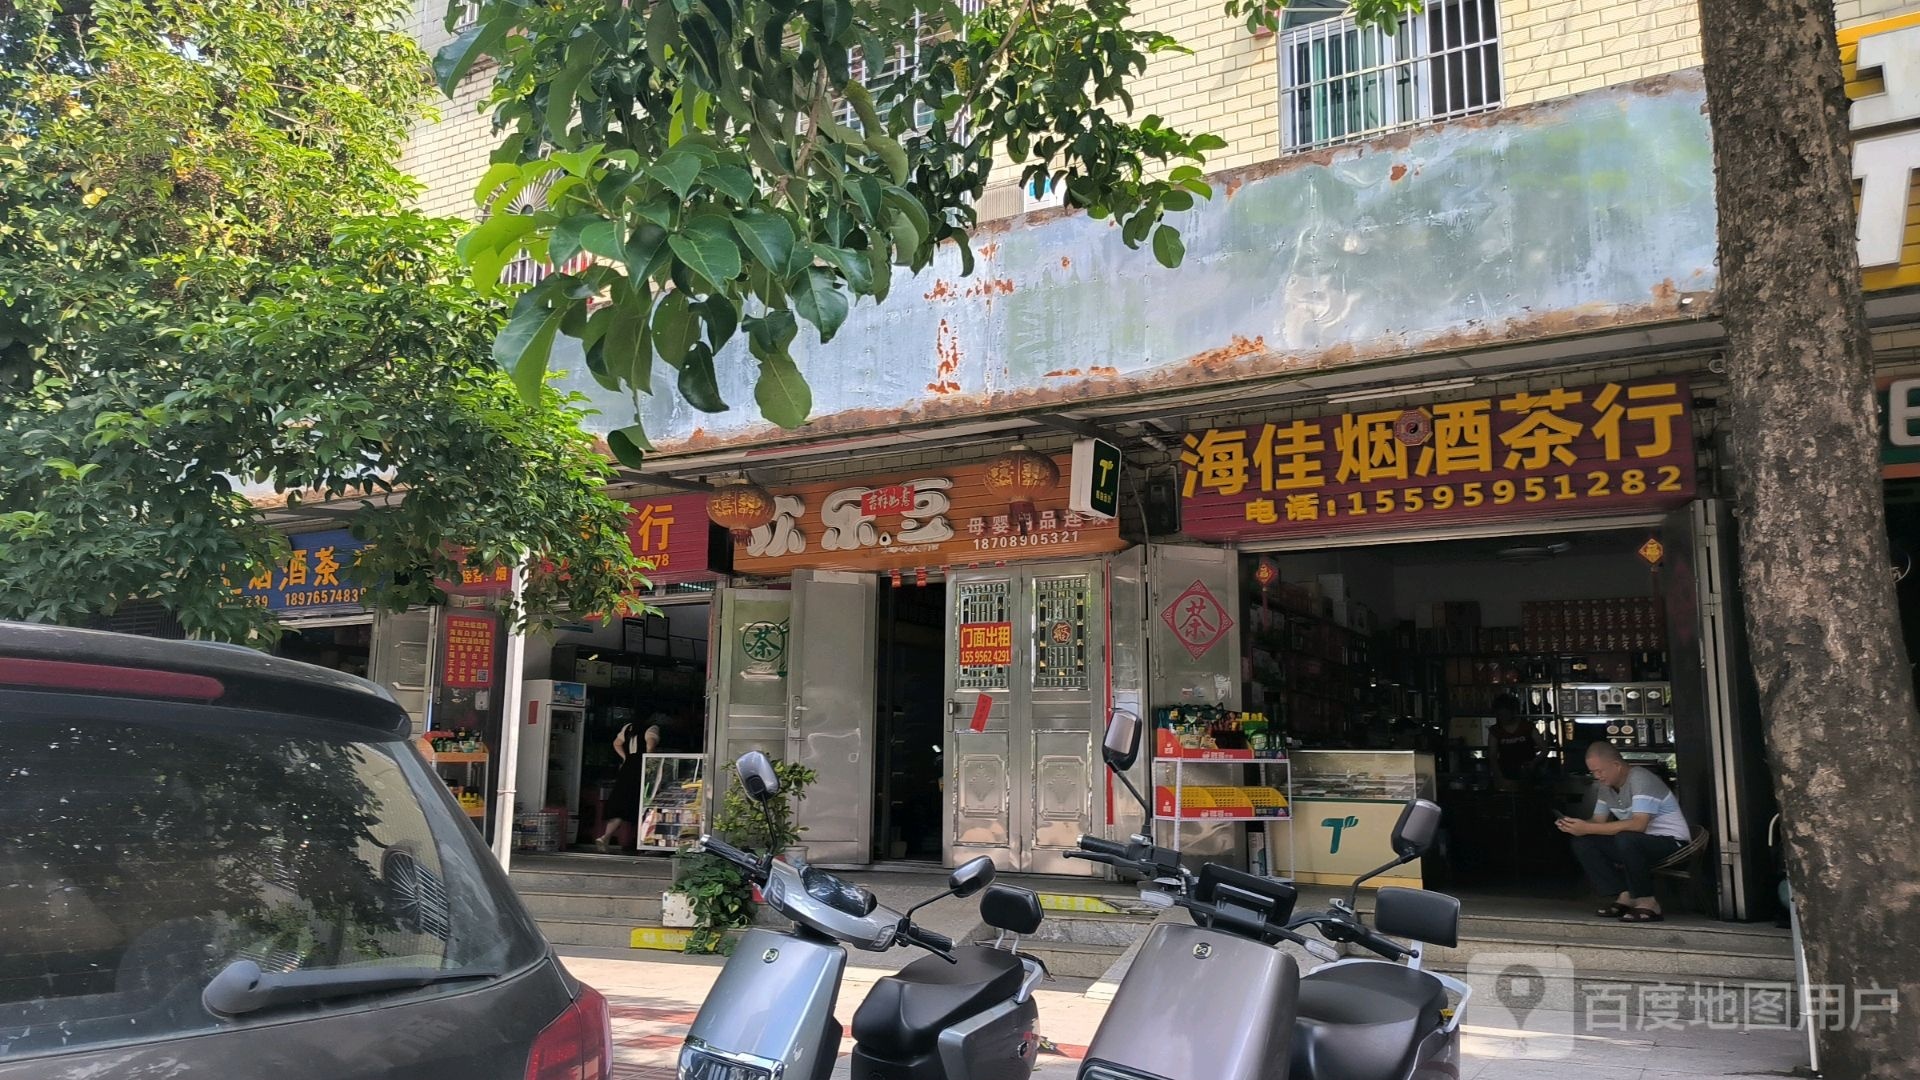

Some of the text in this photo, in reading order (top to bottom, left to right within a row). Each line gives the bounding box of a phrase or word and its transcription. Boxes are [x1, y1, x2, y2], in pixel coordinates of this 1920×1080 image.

[1180, 383, 1684, 498] 海佳烟酒茶行
[974, 531, 1079, 550] 18708905321
[1178, 597, 1217, 640] 茶
[745, 625, 781, 658] 茶
[961, 626, 1011, 648] 门面出租
[961, 649, 1010, 663] 155 9562 4291
